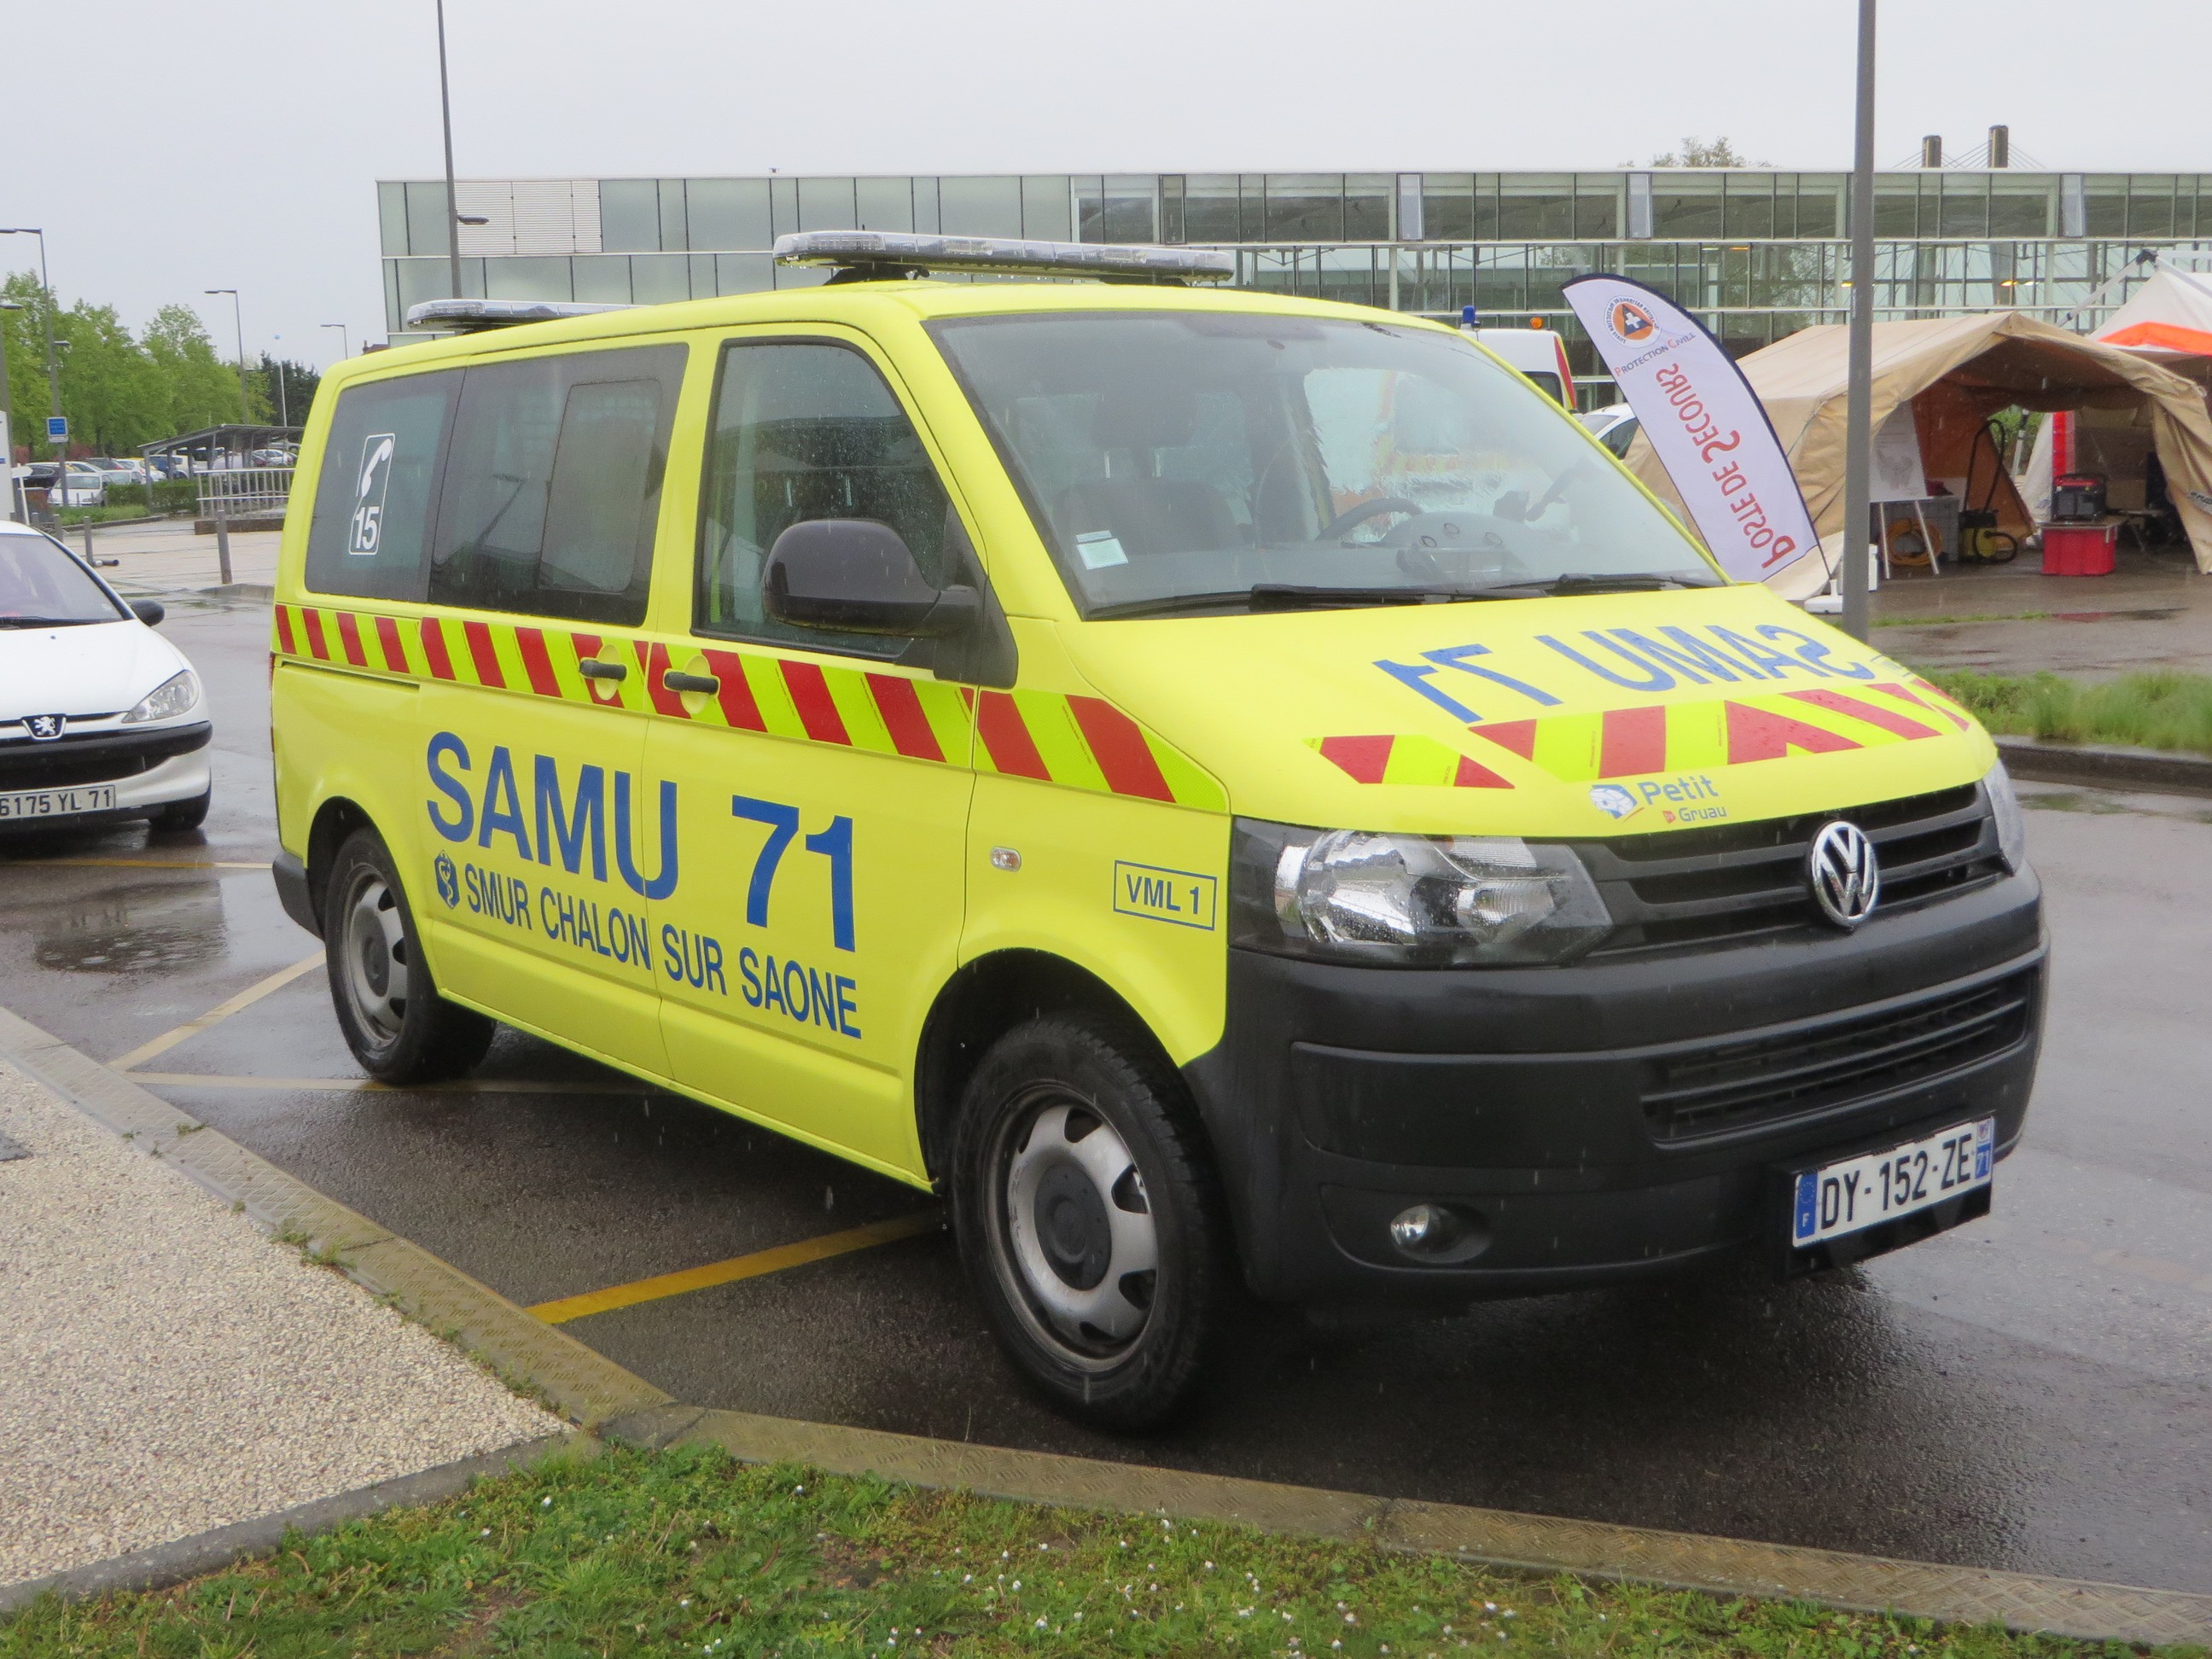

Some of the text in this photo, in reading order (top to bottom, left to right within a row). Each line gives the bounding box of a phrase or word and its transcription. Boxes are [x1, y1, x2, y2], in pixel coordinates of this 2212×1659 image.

[1614, 331, 1697, 377] PROTECTION CIVILE
[355, 506, 380, 550] 15
[0, 789, 110, 816] 6175 YL 71
[1637, 775, 1719, 806] Petit
[1678, 806, 1727, 822] Gruau
[426, 731, 856, 953] SAMU 71
[1126, 873, 1200, 915] VML 1
[465, 863, 862, 1039] SMUR CHALON SUR SAONE
